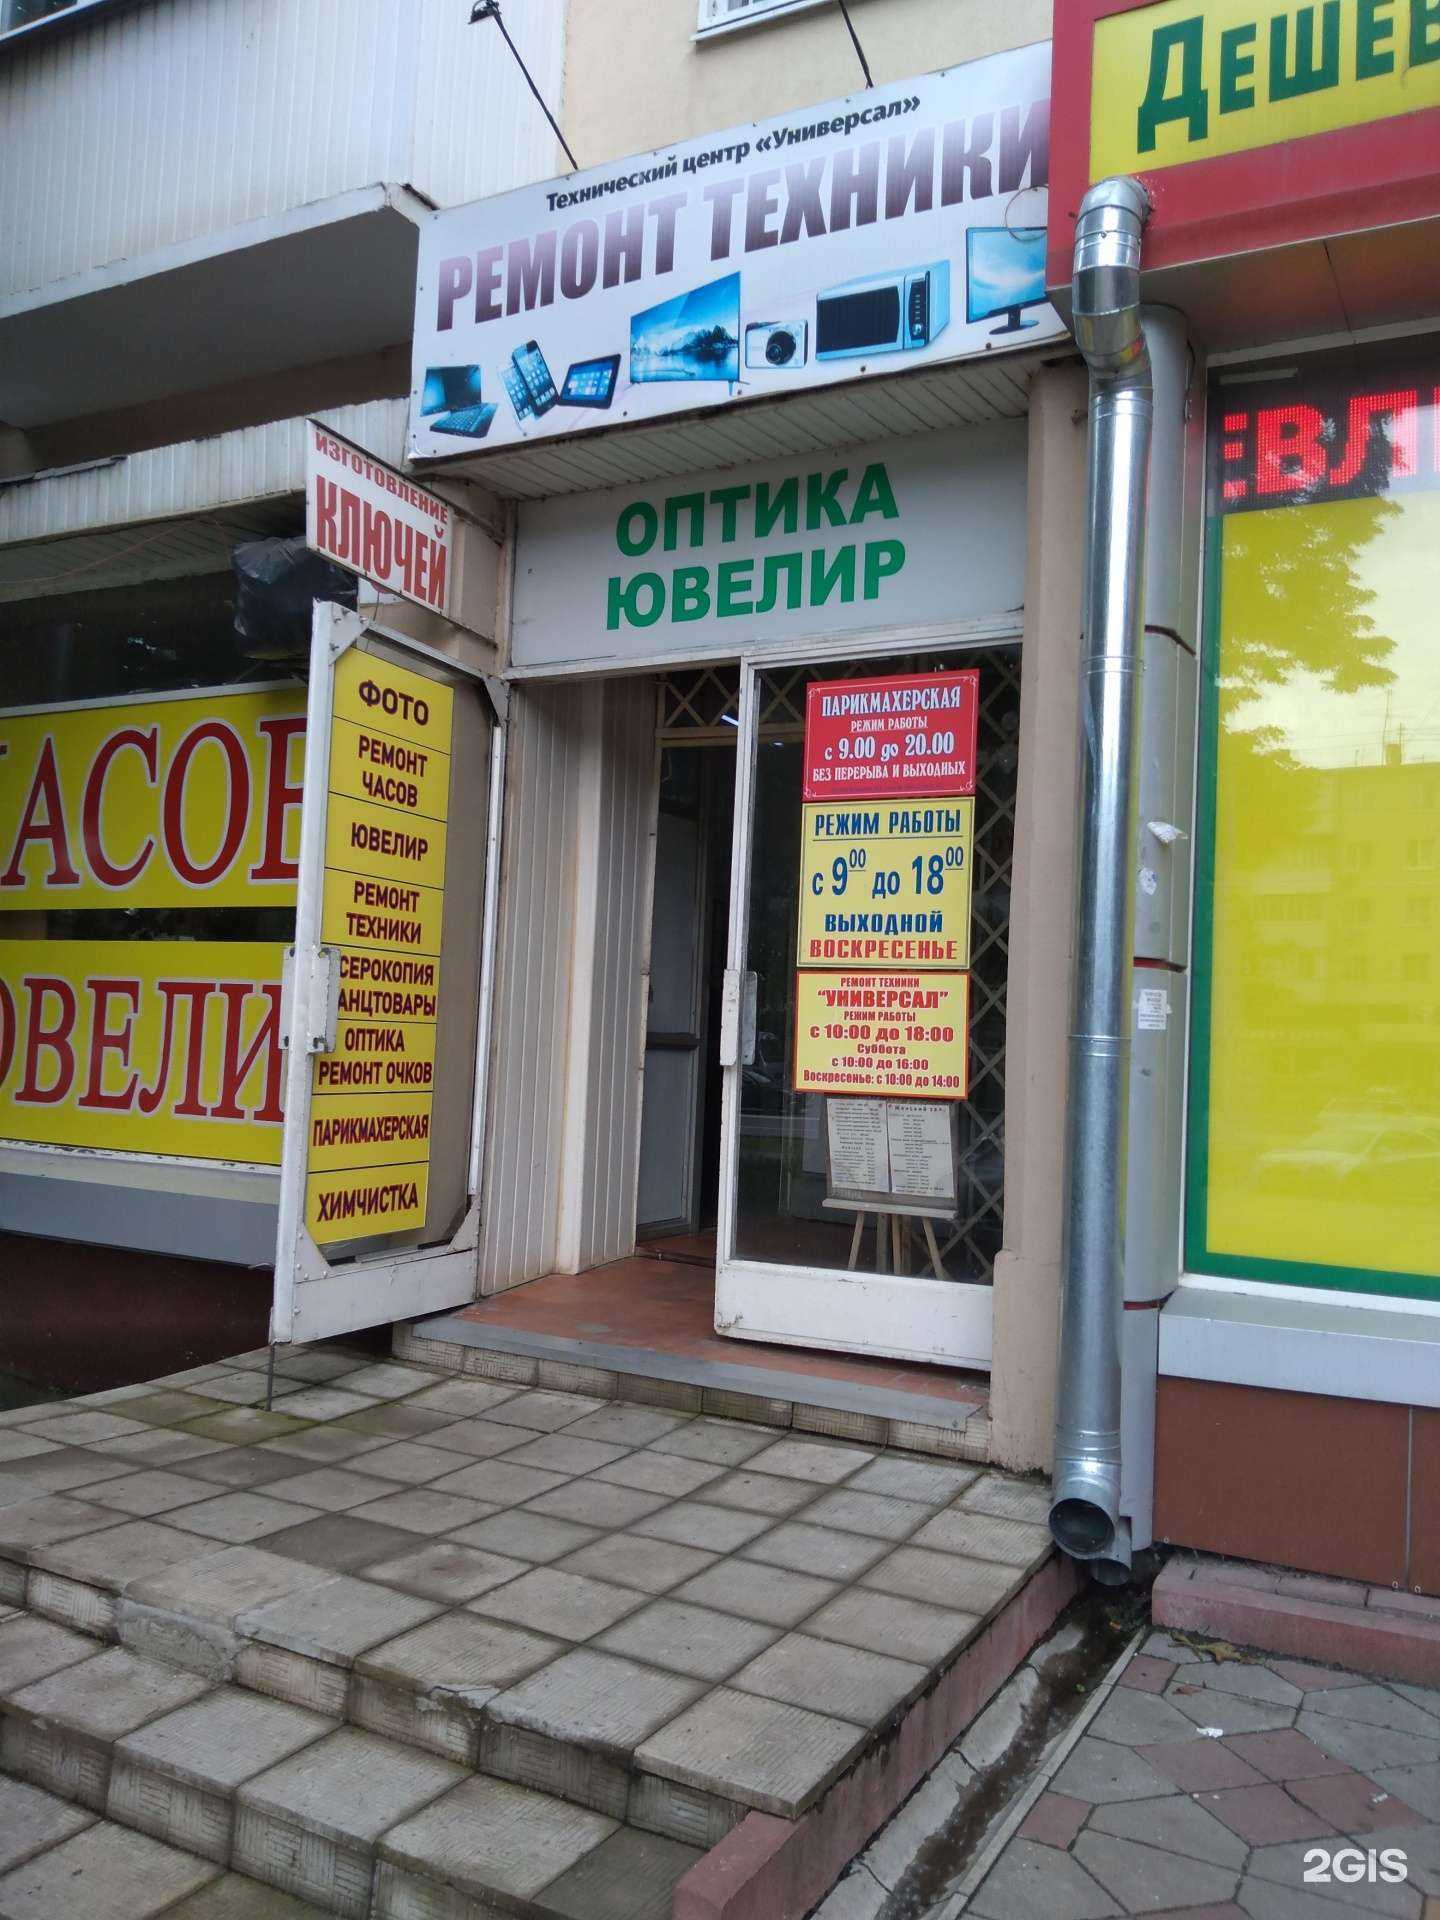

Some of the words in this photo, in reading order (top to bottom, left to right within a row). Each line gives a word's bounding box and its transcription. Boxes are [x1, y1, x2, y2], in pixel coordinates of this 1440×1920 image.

[546, 156, 678, 212] Технический
[682, 141, 751, 175] центр
[756, 96, 921, 153] «Универсал»
[436, 195, 688, 331] РЕМОНТ
[703, 101, 1052, 261] ТЕХНИКИ
[1223, 384, 1440, 498] ВЛ
[315, 431, 449, 524] ИЗГОТОВЛЕНИЕ
[615, 462, 900, 557] ОПТИКА
[316, 474, 448, 610] КЛЮЧЕЙ
[606, 539, 907, 631] ЮВЕЛИР
[358, 679, 429, 726] ФОТО
[821, 685, 961, 717] ПАРИКМАХЕРСКАЯ
[850, 719, 885, 732] РЕЖИМ
[888, 716, 928, 731] РАБОТЫ
[358, 734, 428, 778] РЕМОНТ
[838, 736, 876, 759] 9.00
[905, 731, 955, 756] 20.00
[812, 767, 832, 782] БЕЗ
[834, 764, 889, 781] ПЕРЕРЫВА
[892, 764, 900, 778] И
[903, 761, 966, 778] ВЫХОДНЫХ
[0, 716, 307, 887] АСОВ
[362, 771, 418, 808] ЧАСОВ
[815, 812, 880, 837] РЕЖИМ
[889, 809, 961, 834] РАБОТЫ
[351, 821, 428, 862] ЮВЕЛИР
[353, 880, 420, 913] РЕМОНТ
[346, 912, 422, 945] ТЕХНИКИ
[825, 910, 943, 935] ВЫХОДНОЙ
[809, 939, 958, 960] ВОСКРЕСЕНЬЕ
[340, 955, 434, 986] СЕРОКОПИЯ
[840, 977, 876, 988] РЕМОНТ
[879, 978, 920, 988] ТЕХНИКИ
[338, 988, 436, 1017] АНЦТОВАРЫ
[843, 1011, 876, 1021] РЕЖИМ
[878, 1011, 916, 1022] РАБОТЫ
[344, 1028, 405, 1052] ОПТИКА
[824, 1024, 871, 1040] 10:00
[875, 1028, 900, 1042] до
[905, 1026, 954, 1042] 18:00
[857, 1043, 906, 1055] Суббота
[0, 977, 286, 1123] ВЕЛИ
[842, 1057, 873, 1068] 10:00
[876, 1059, 893, 1070] до
[896, 1058, 929, 1070] 16:00
[318, 1061, 383, 1086] РЕМОНТ
[386, 1061, 433, 1085] ОЧКОВ
[803, 1069, 874, 1084] Воскресенье:
[885, 1074, 912, 1085] 10:00
[915, 1077, 929, 1088] до
[932, 1075, 960, 1088] 14:00
[313, 1114, 429, 1147] ПАРИКМАХЕРСКАЯ
[316, 1182, 419, 1223] ХИМЧИСТКА
